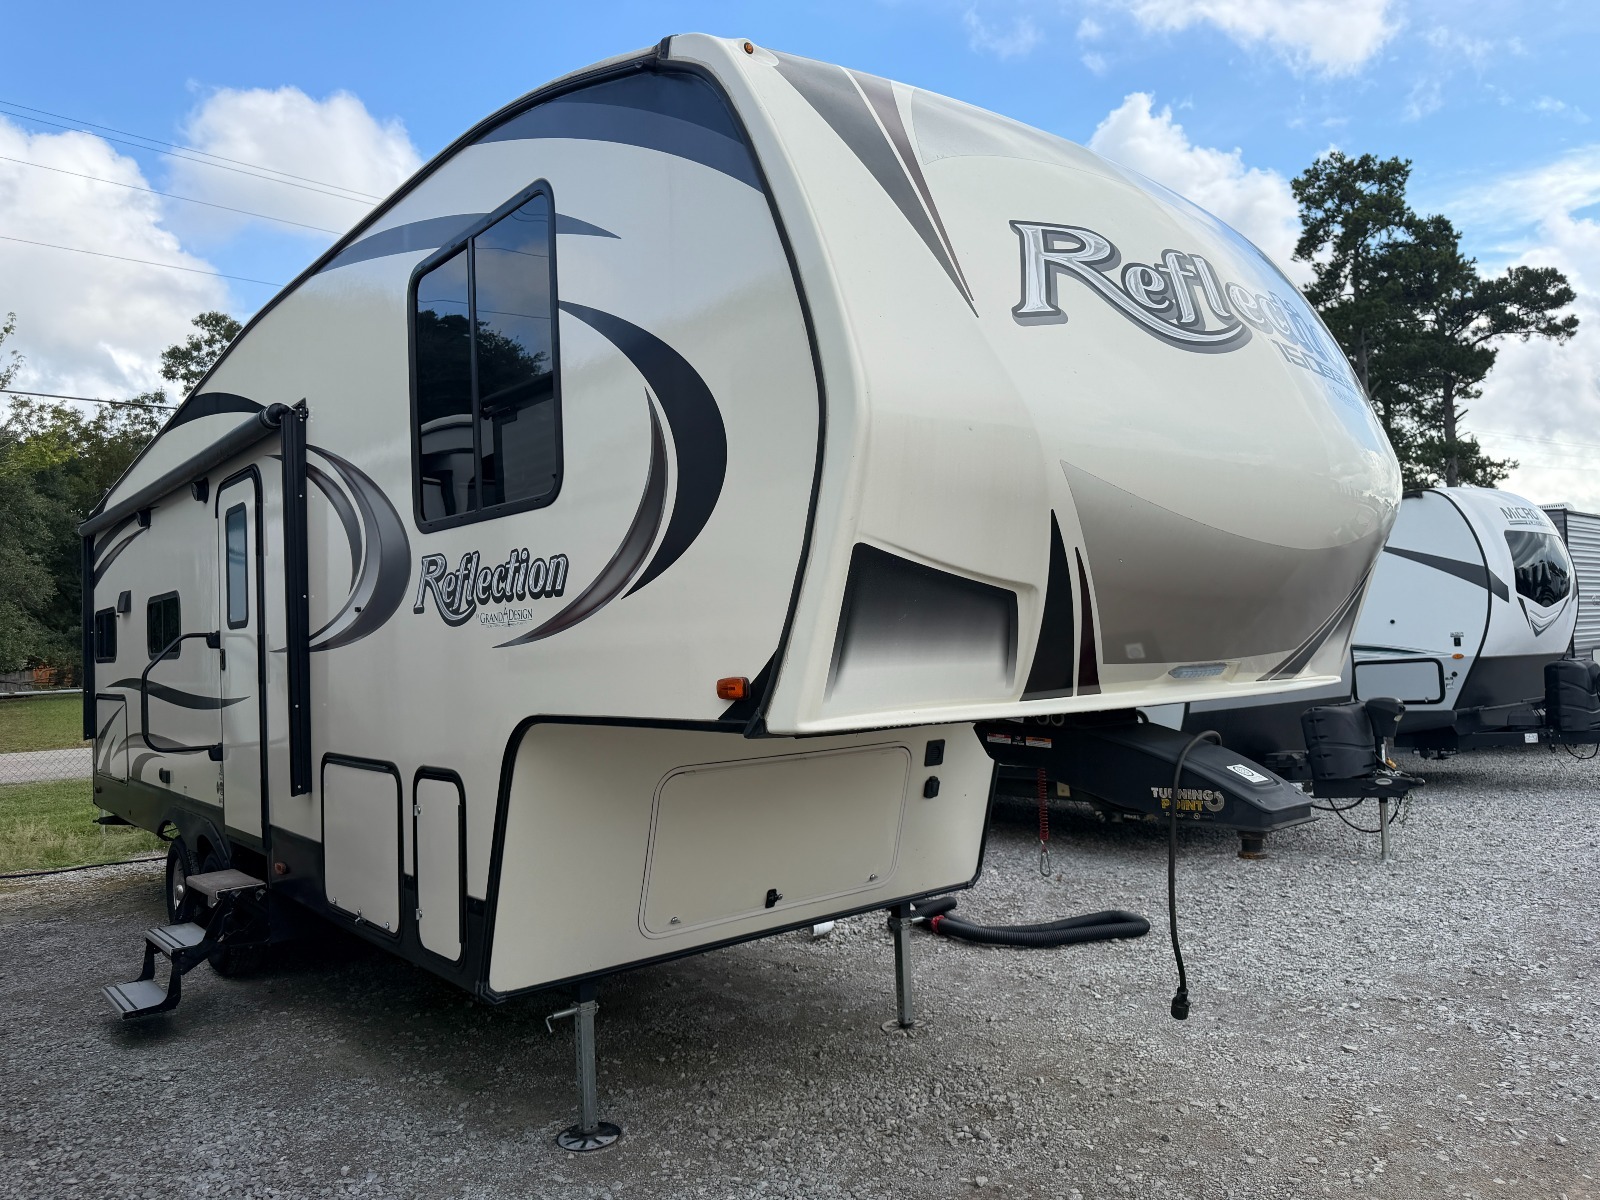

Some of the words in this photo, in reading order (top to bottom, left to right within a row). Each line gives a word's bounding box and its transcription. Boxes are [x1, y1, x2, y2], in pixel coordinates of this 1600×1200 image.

[1009, 219, 1347, 354] Reflectio
[413, 547, 569, 627] Reflection
[480, 611, 505, 624] GRAND
[508, 608, 533, 621] DESIGN
